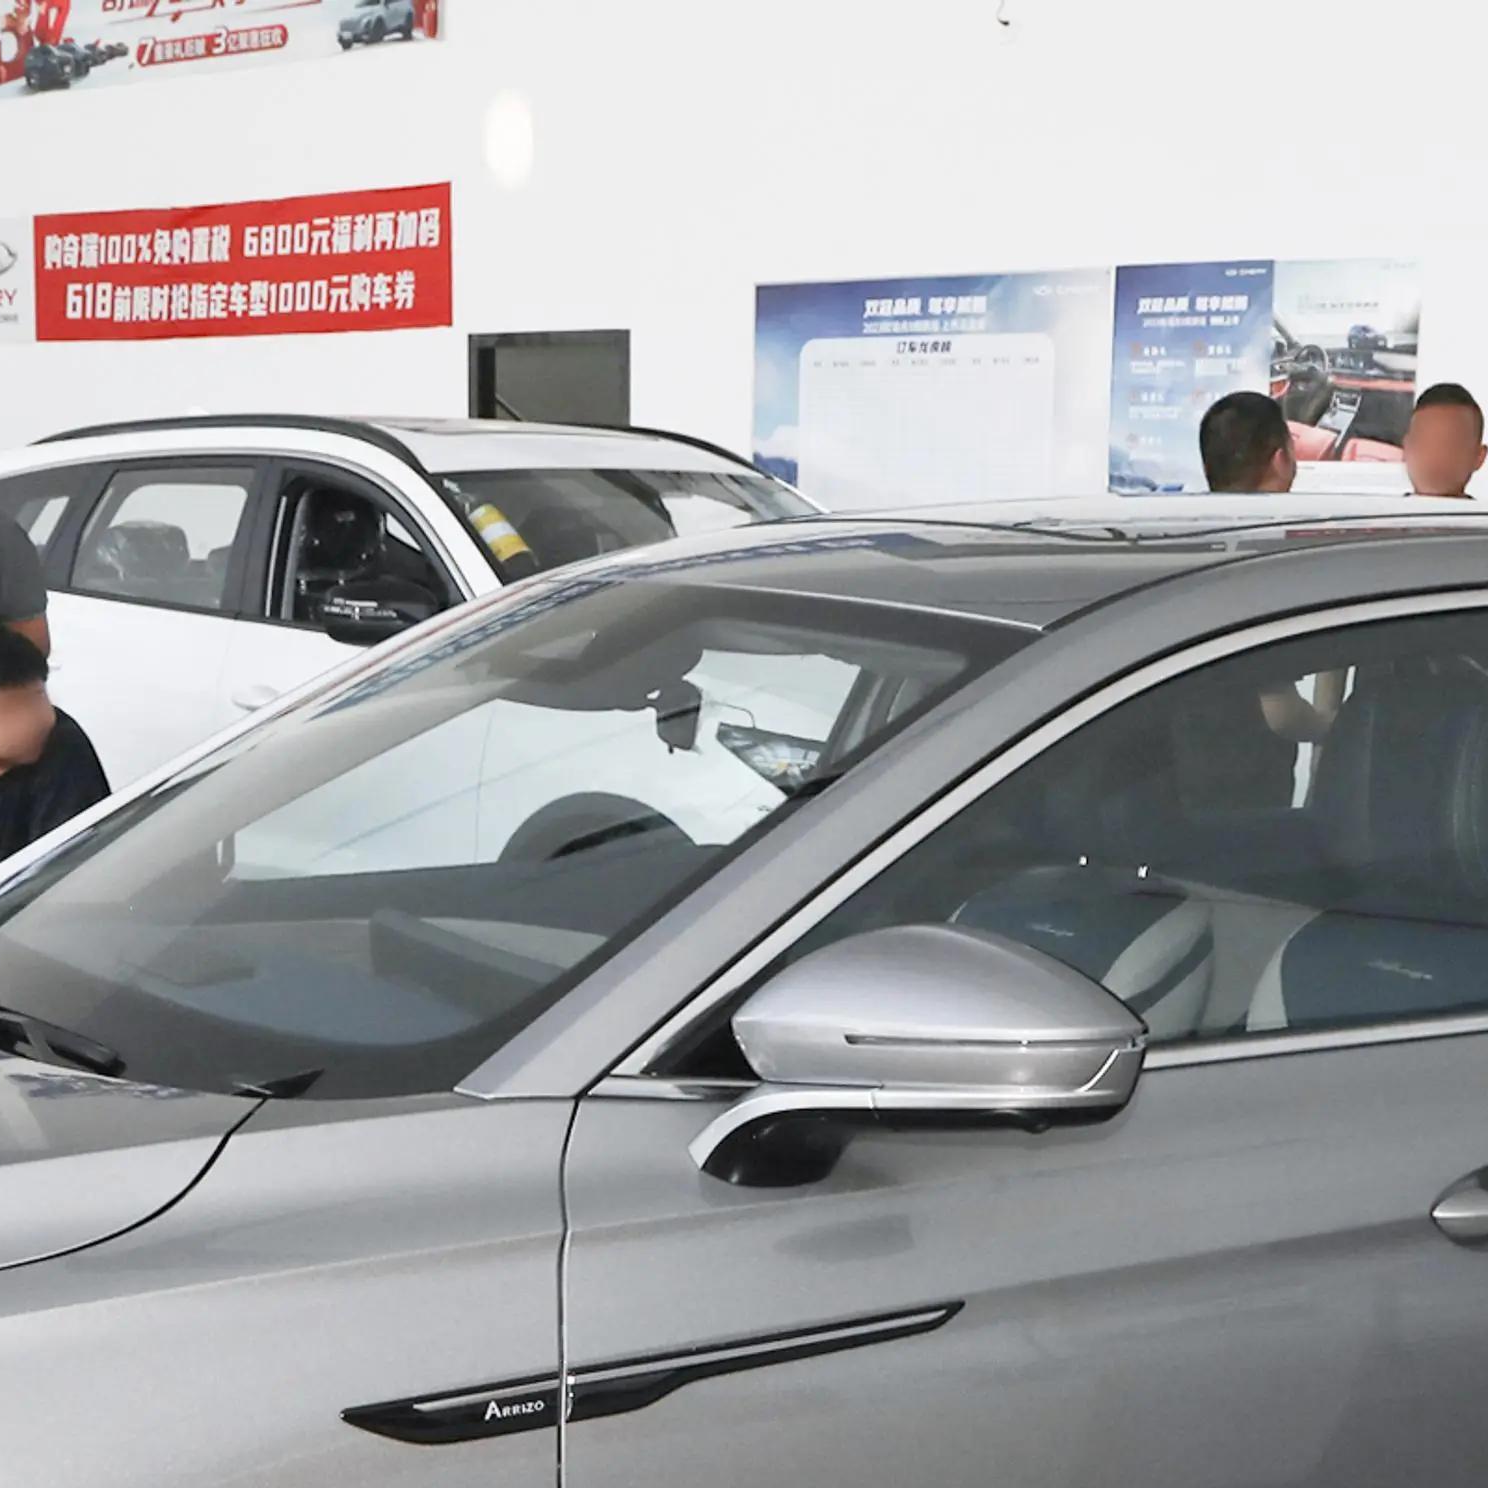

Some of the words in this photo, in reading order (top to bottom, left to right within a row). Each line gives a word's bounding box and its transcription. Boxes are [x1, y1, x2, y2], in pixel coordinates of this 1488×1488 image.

[243, 207, 440, 257] 6800元福利再加码
[484, 1400, 545, 1421] ARRIZO
